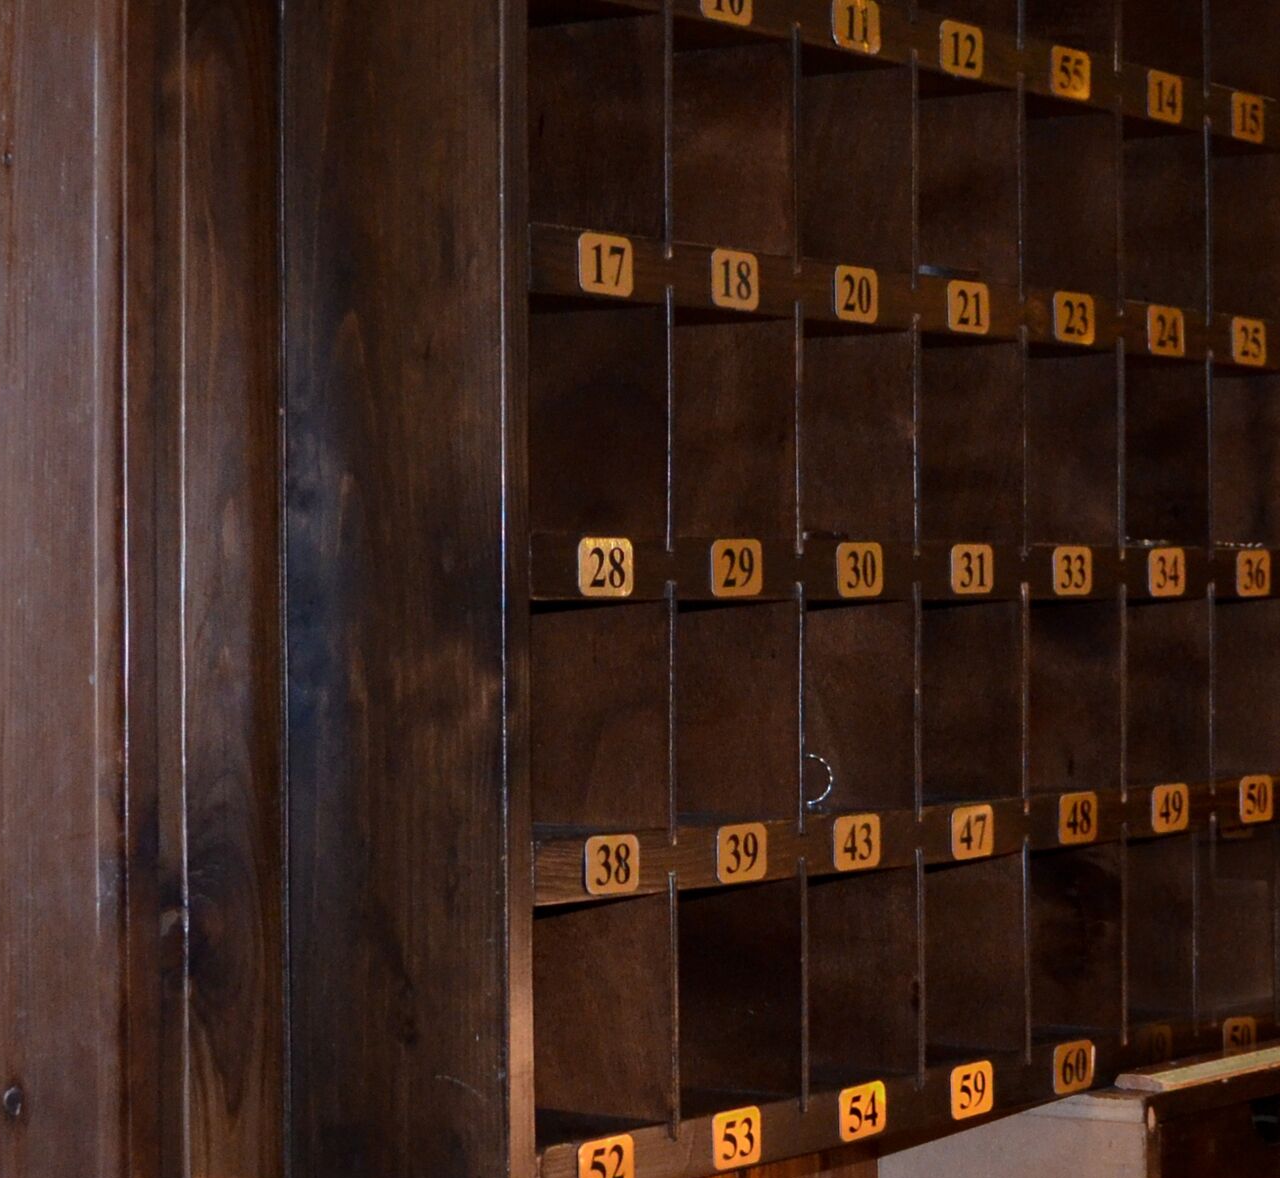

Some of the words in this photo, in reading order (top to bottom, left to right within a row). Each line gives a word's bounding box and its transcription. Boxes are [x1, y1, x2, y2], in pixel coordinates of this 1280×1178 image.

[846, 4, 869, 43] 11
[951, 31, 977, 70] 12
[1059, 55, 1083, 89] 55
[1157, 81, 1177, 114] 14
[1241, 102, 1260, 134] 15
[593, 244, 626, 286] 17
[722, 259, 752, 300] 18
[843, 273, 872, 314] 20
[957, 289, 981, 327] 21
[1064, 300, 1088, 336] 23
[1157, 314, 1179, 349] 24
[1240, 325, 1262, 358] 25
[589, 547, 626, 589] 28
[722, 547, 755, 588] 29
[847, 550, 876, 589] 30
[960, 551, 985, 588] 31
[1061, 554, 1086, 589] 33
[1157, 555, 1181, 588] 34
[1244, 557, 1267, 589] 36
[1066, 799, 1092, 835] 48
[1159, 790, 1183, 824] 49
[1246, 783, 1268, 815] 50
[843, 823, 873, 861] 43
[960, 814, 987, 851] 47
[595, 843, 631, 886] 38
[726, 832, 759, 874] 39
[1061, 1048, 1088, 1085] 60
[960, 1070, 986, 1110] 59
[848, 1092, 879, 1134] 54
[723, 1117, 754, 1161] 53
